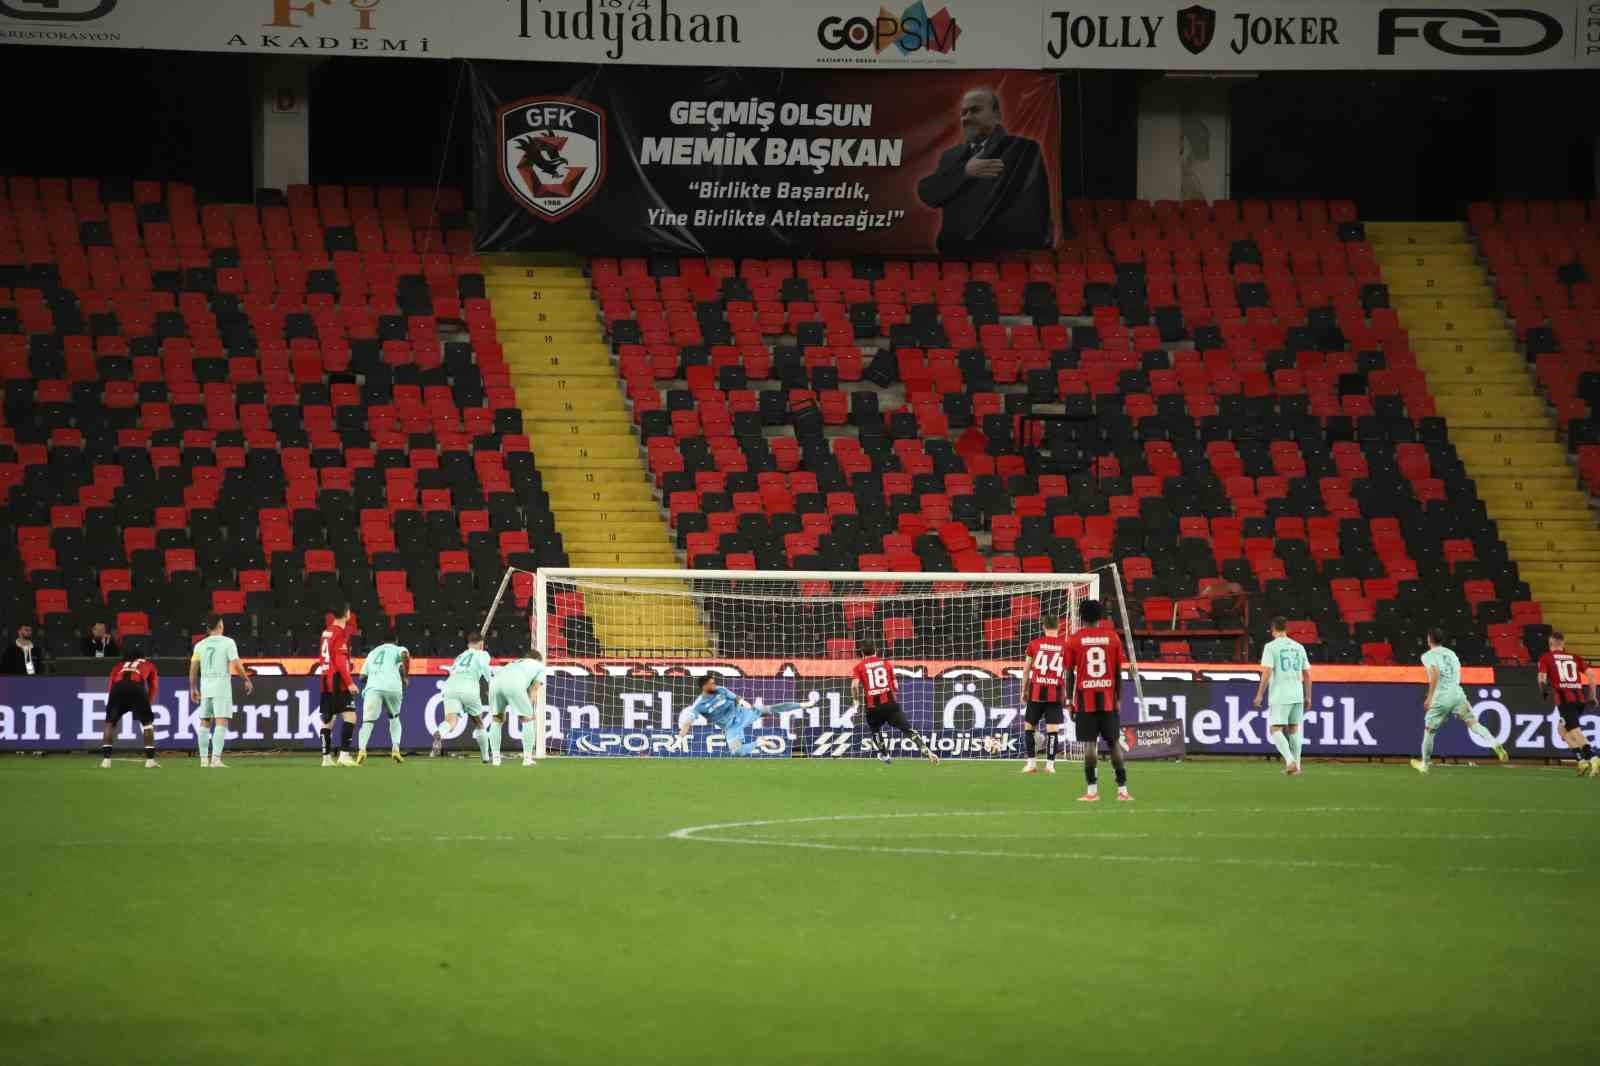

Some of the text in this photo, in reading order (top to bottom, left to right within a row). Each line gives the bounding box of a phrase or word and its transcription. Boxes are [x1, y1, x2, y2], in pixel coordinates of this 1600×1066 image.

[227, 33, 433, 53] AKADEMİ
[817, 16, 957, 52] GOPSM
[1047, 11, 1165, 59] JOLLY
[1231, 13, 1341, 55] JOKER
[526, 106, 576, 129] GFK
[670, 98, 873, 131] GEÇMİŞ OLSUN
[640, 133, 903, 174] MEMİK BAŞKAN
[777, 182, 869, 201] Başardık,
[648, 208, 688, 226] Yine
[694, 208, 765, 227] Birlikte
[205, 646, 217, 669] 7
[373, 650, 387, 667] 4
[1033, 650, 1065, 676] 44
[1086, 646, 1107, 679] 8
[866, 667, 889, 689] 18
[1555, 660, 1578, 682] 10
[1137, 726, 1181, 738] trendyol
